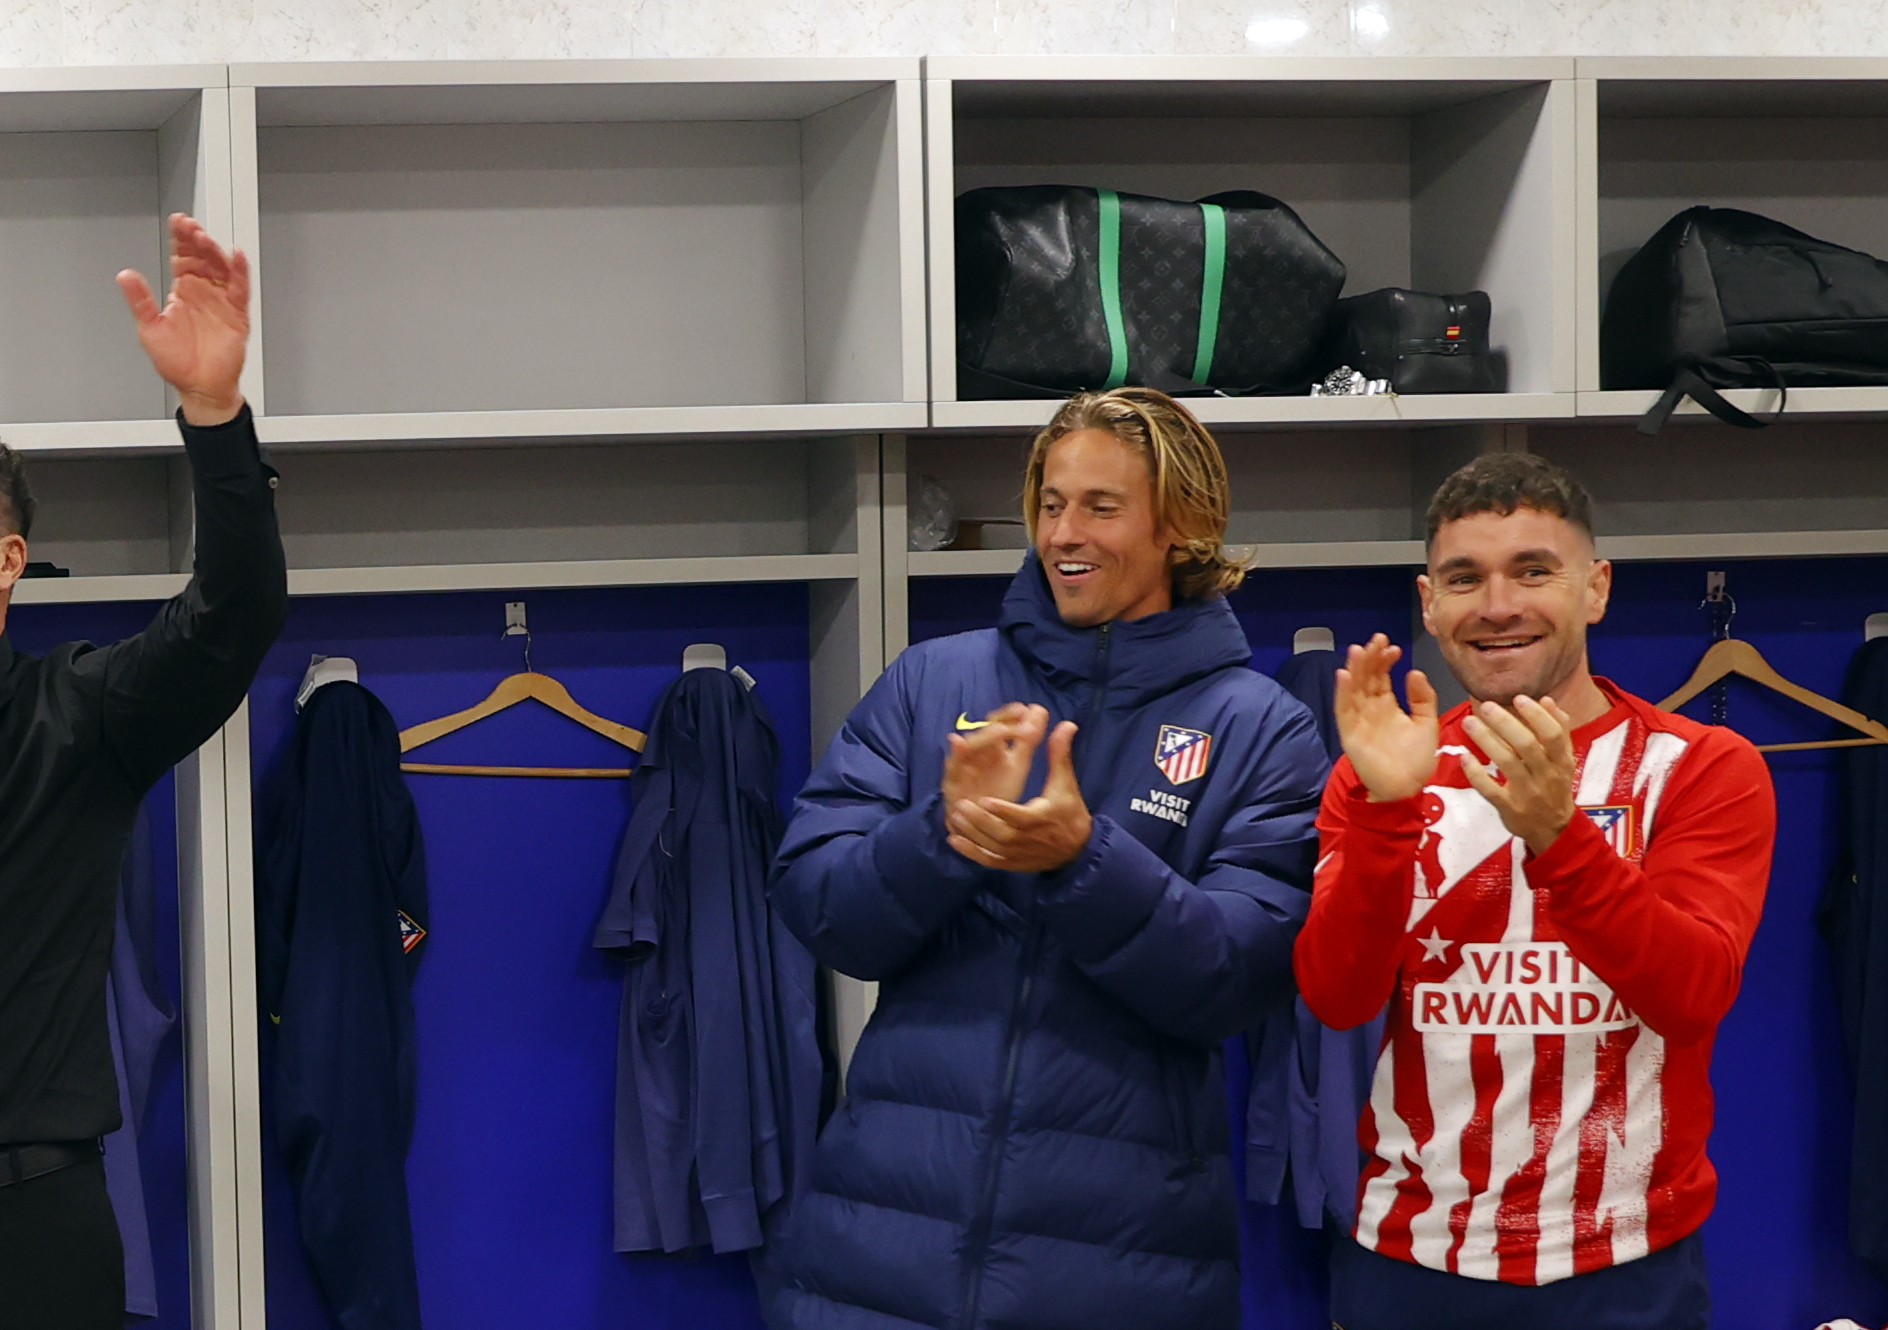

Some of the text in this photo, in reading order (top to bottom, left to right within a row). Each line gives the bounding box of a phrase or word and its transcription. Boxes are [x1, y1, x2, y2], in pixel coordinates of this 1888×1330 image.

[1130, 797, 1188, 828] RWAN
[1149, 789, 1191, 812] VISIT
[1470, 949, 1582, 985] VISIT
[1421, 990, 1634, 1026] RWANDA
